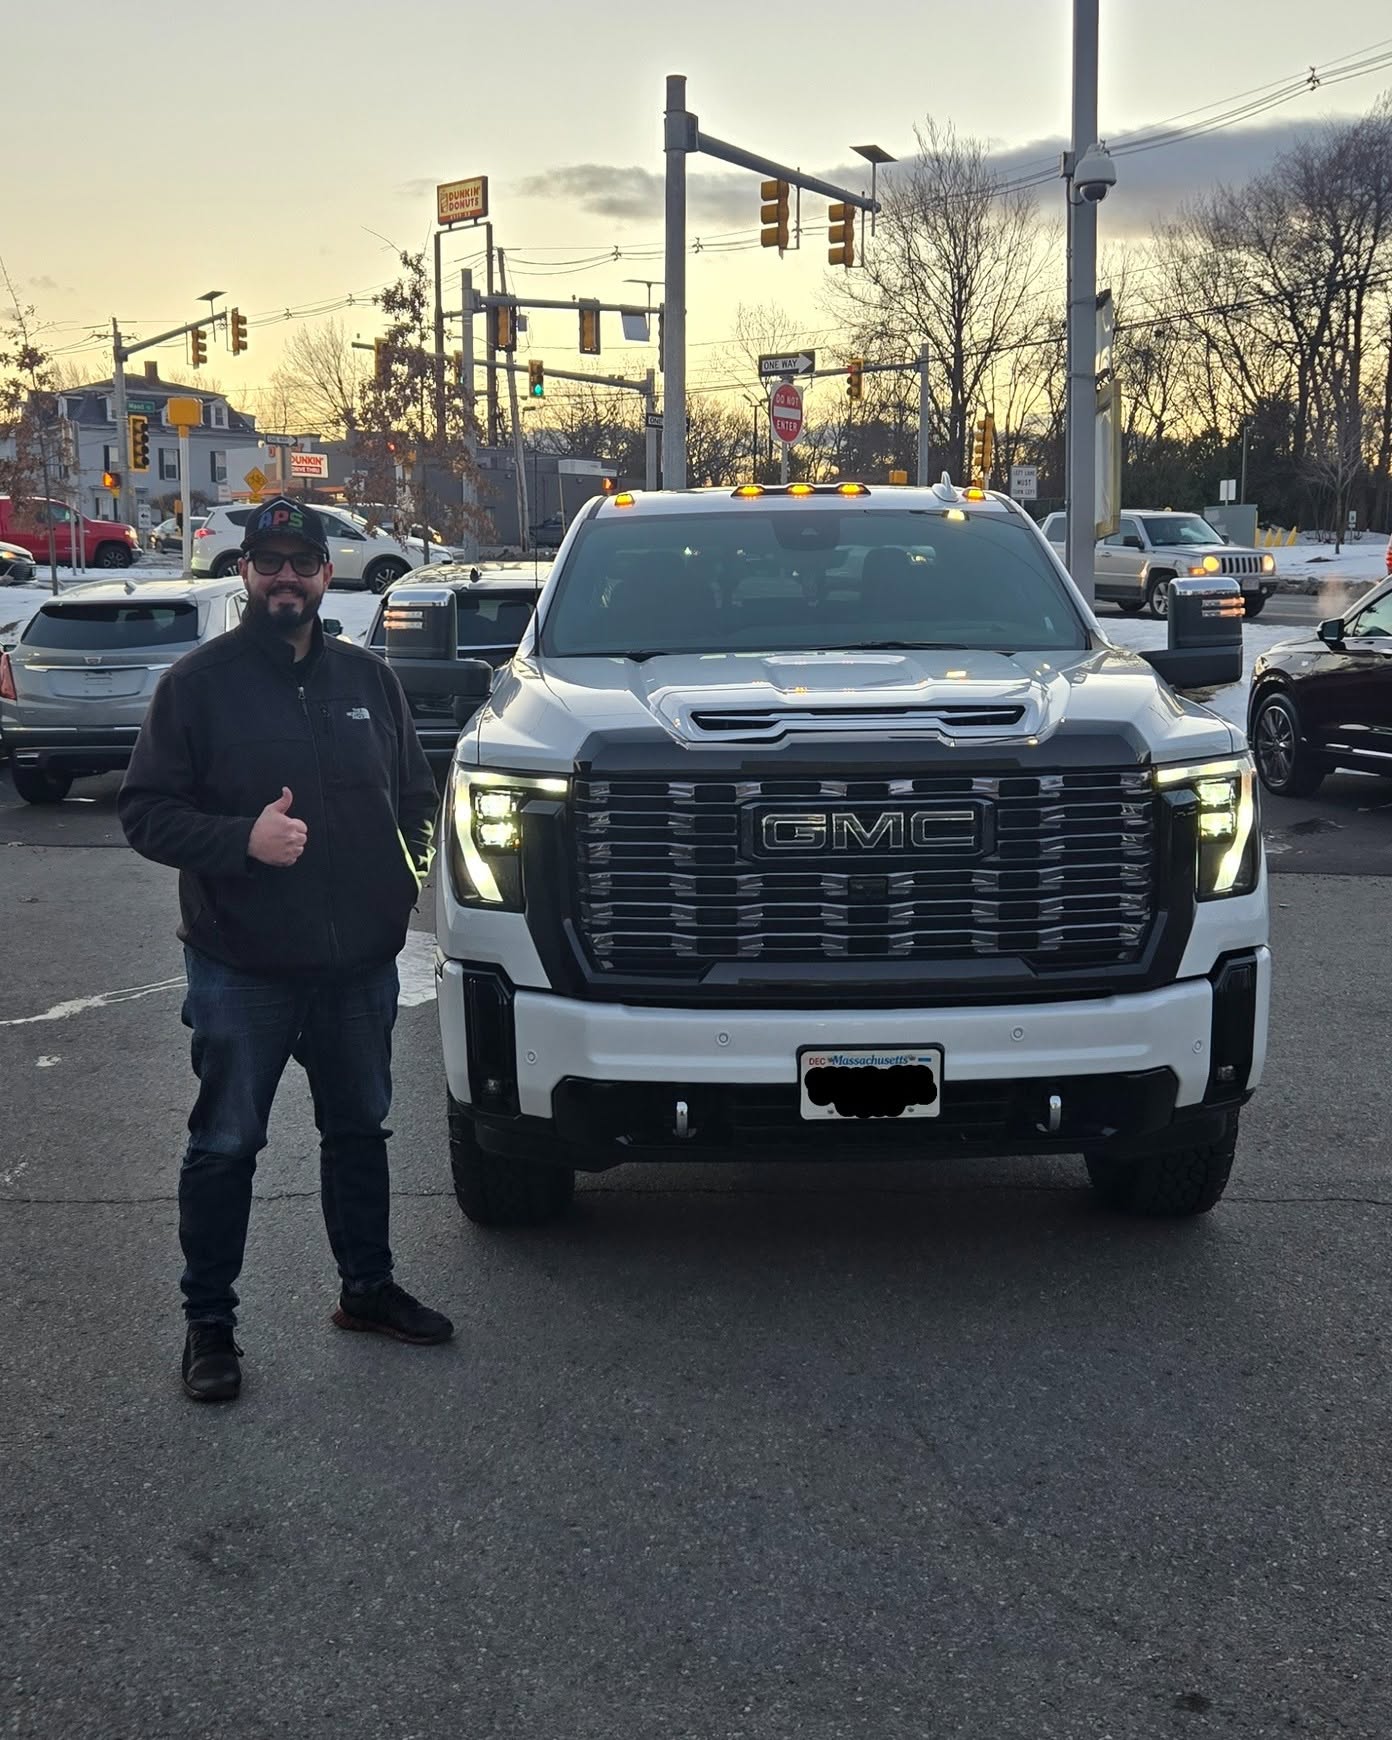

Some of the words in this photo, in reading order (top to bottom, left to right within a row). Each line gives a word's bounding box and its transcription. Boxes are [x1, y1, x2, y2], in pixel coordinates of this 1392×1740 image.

[449, 186, 480, 201] DUNKIN'
[449, 197, 479, 211] DONUTS
[764, 361, 779, 370] ONE
[782, 360, 798, 368] WAY
[776, 394, 785, 404] DO
[787, 396, 799, 407] NOT
[777, 420, 798, 432] ENTER
[258, 510, 304, 529] APS
[762, 810, 975, 850] GMC
[808, 1057, 826, 1066] DEC
[831, 1054, 909, 1066] Massachusetts
